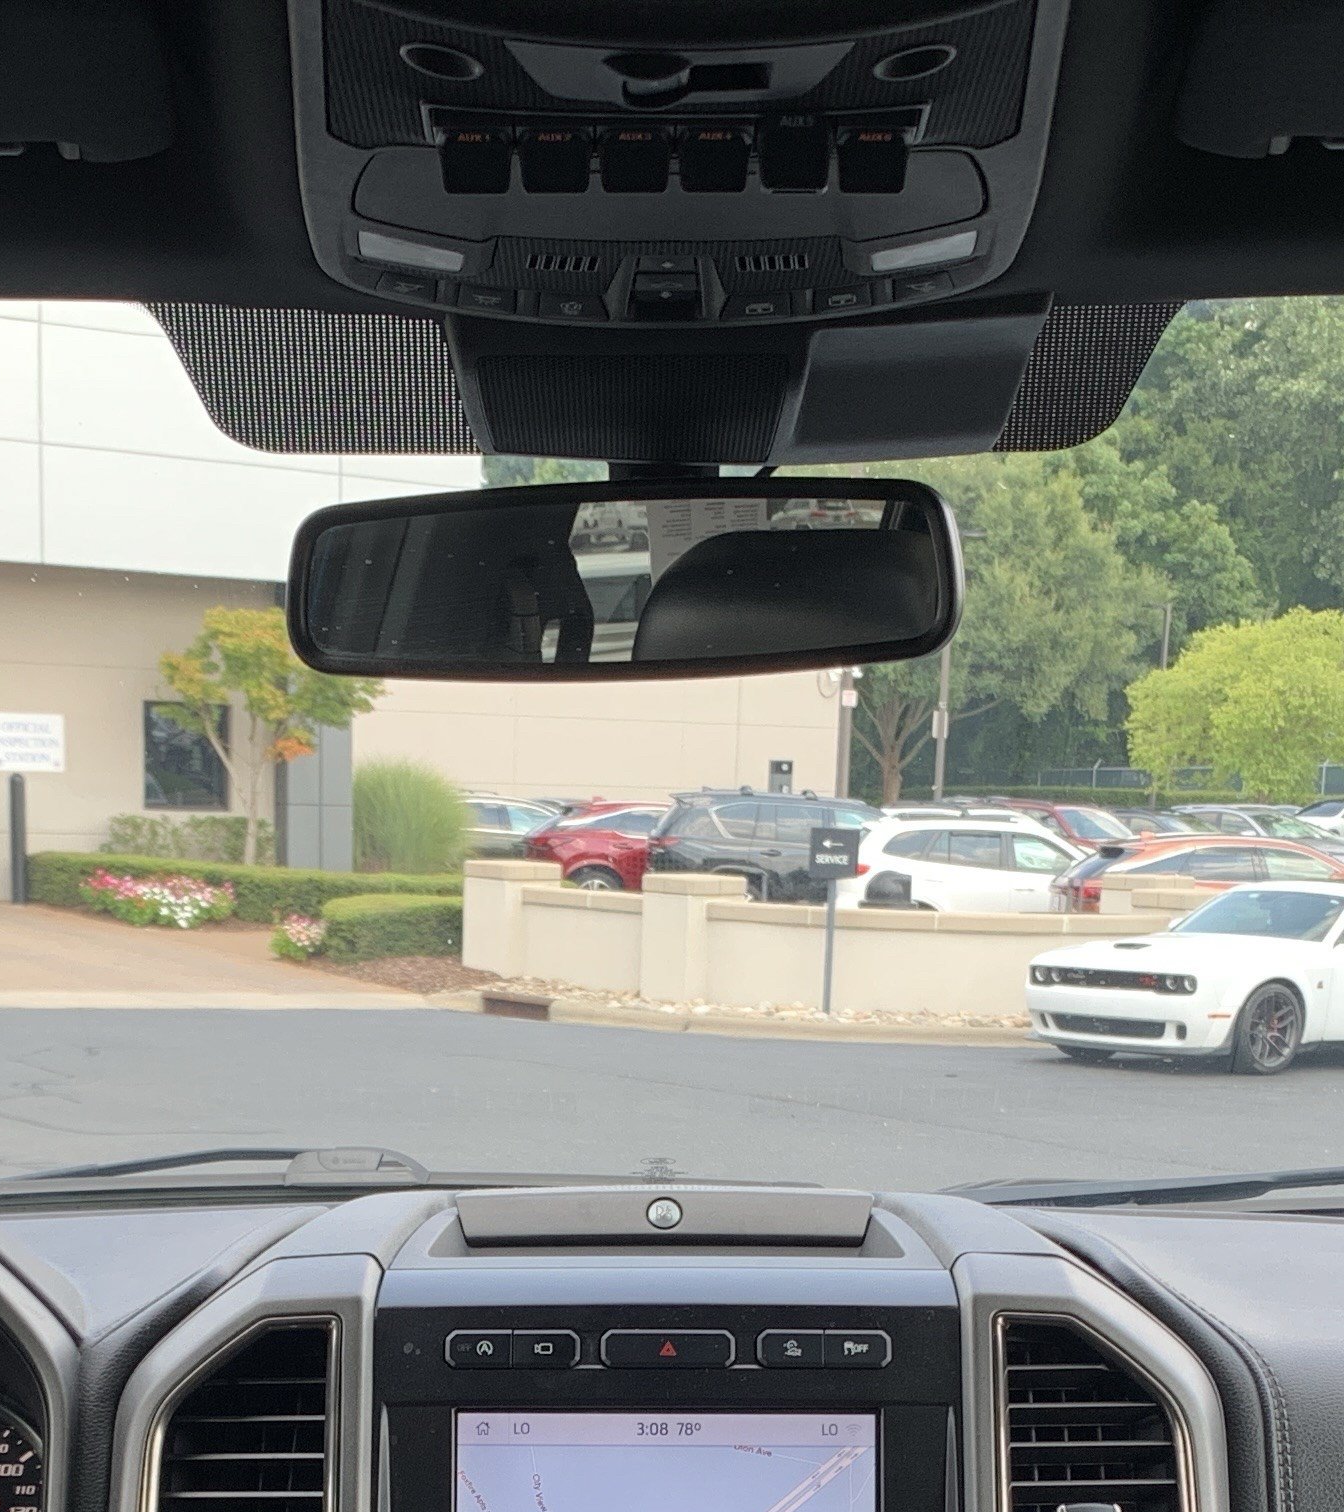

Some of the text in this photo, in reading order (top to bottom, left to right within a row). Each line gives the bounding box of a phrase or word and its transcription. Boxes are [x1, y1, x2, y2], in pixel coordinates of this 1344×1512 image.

[814, 853, 850, 866] SERVICE
[513, 1422, 530, 1435] LO
[636, 1422, 669, 1436] 3:08
[821, 1423, 839, 1436] LO
[755, 1447, 773, 1458] Ave
[532, 1473, 541, 1491] City
[15, 1485, 36, 1495] 110
[536, 1492, 548, 1512] View
